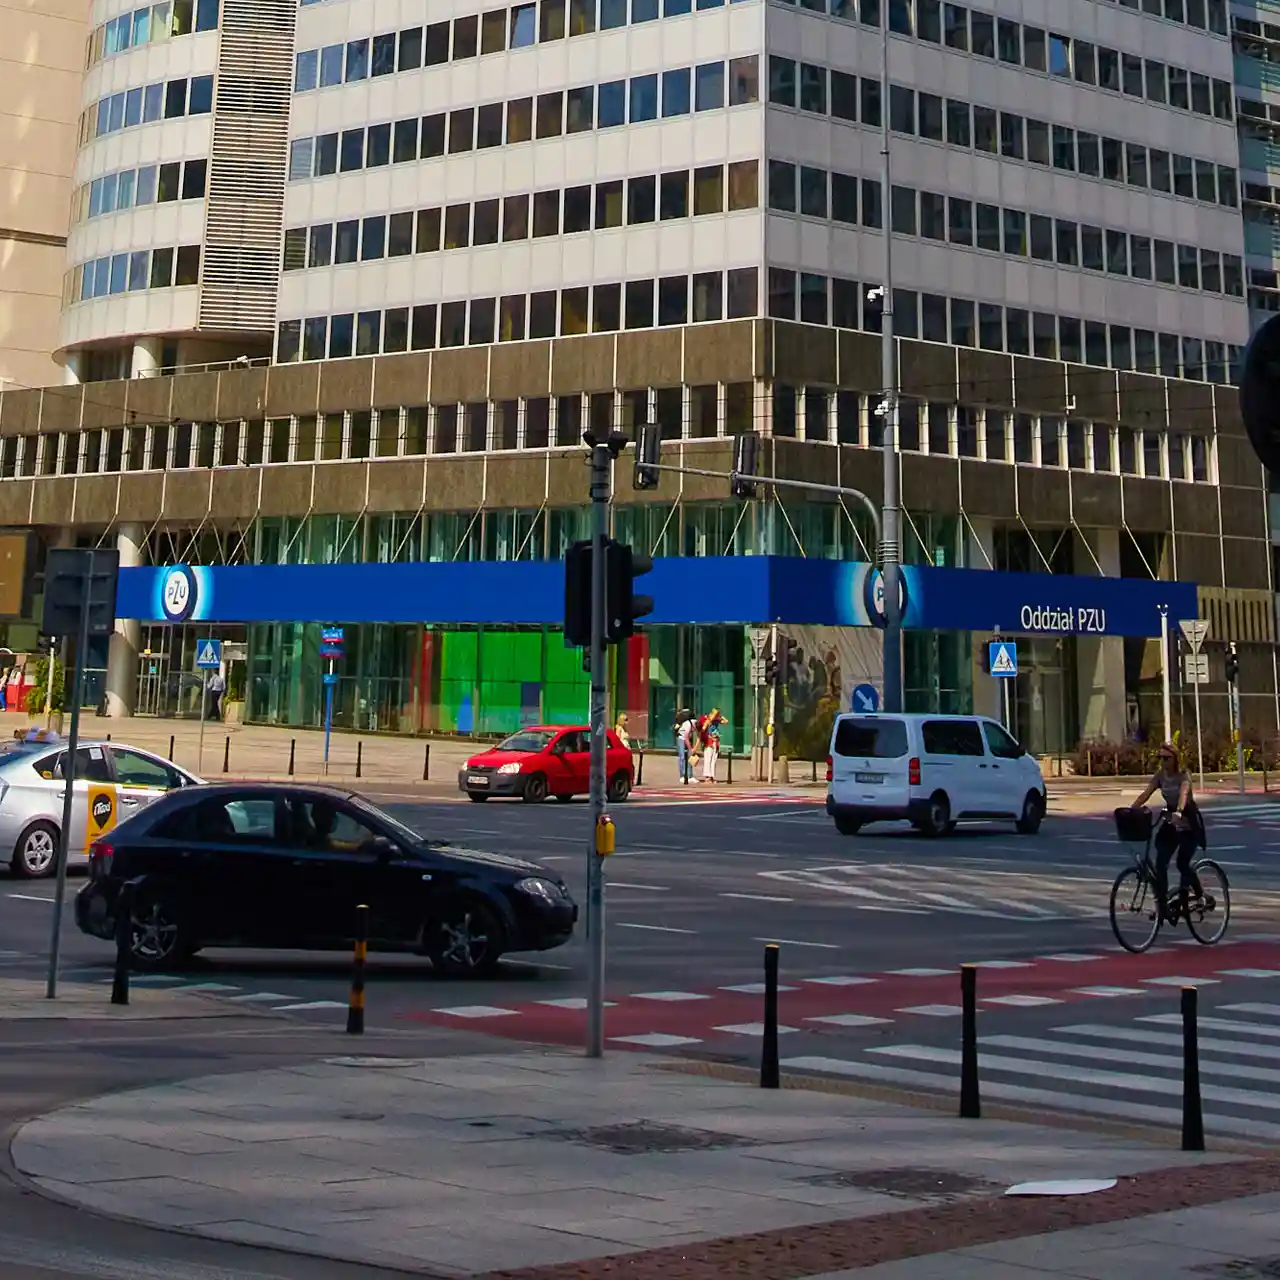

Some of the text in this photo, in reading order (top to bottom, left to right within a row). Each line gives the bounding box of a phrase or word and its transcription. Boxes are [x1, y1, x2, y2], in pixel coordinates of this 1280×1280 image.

[168, 580, 186, 605] PZU
[1021, 605, 1105, 632] Oddział PZU
